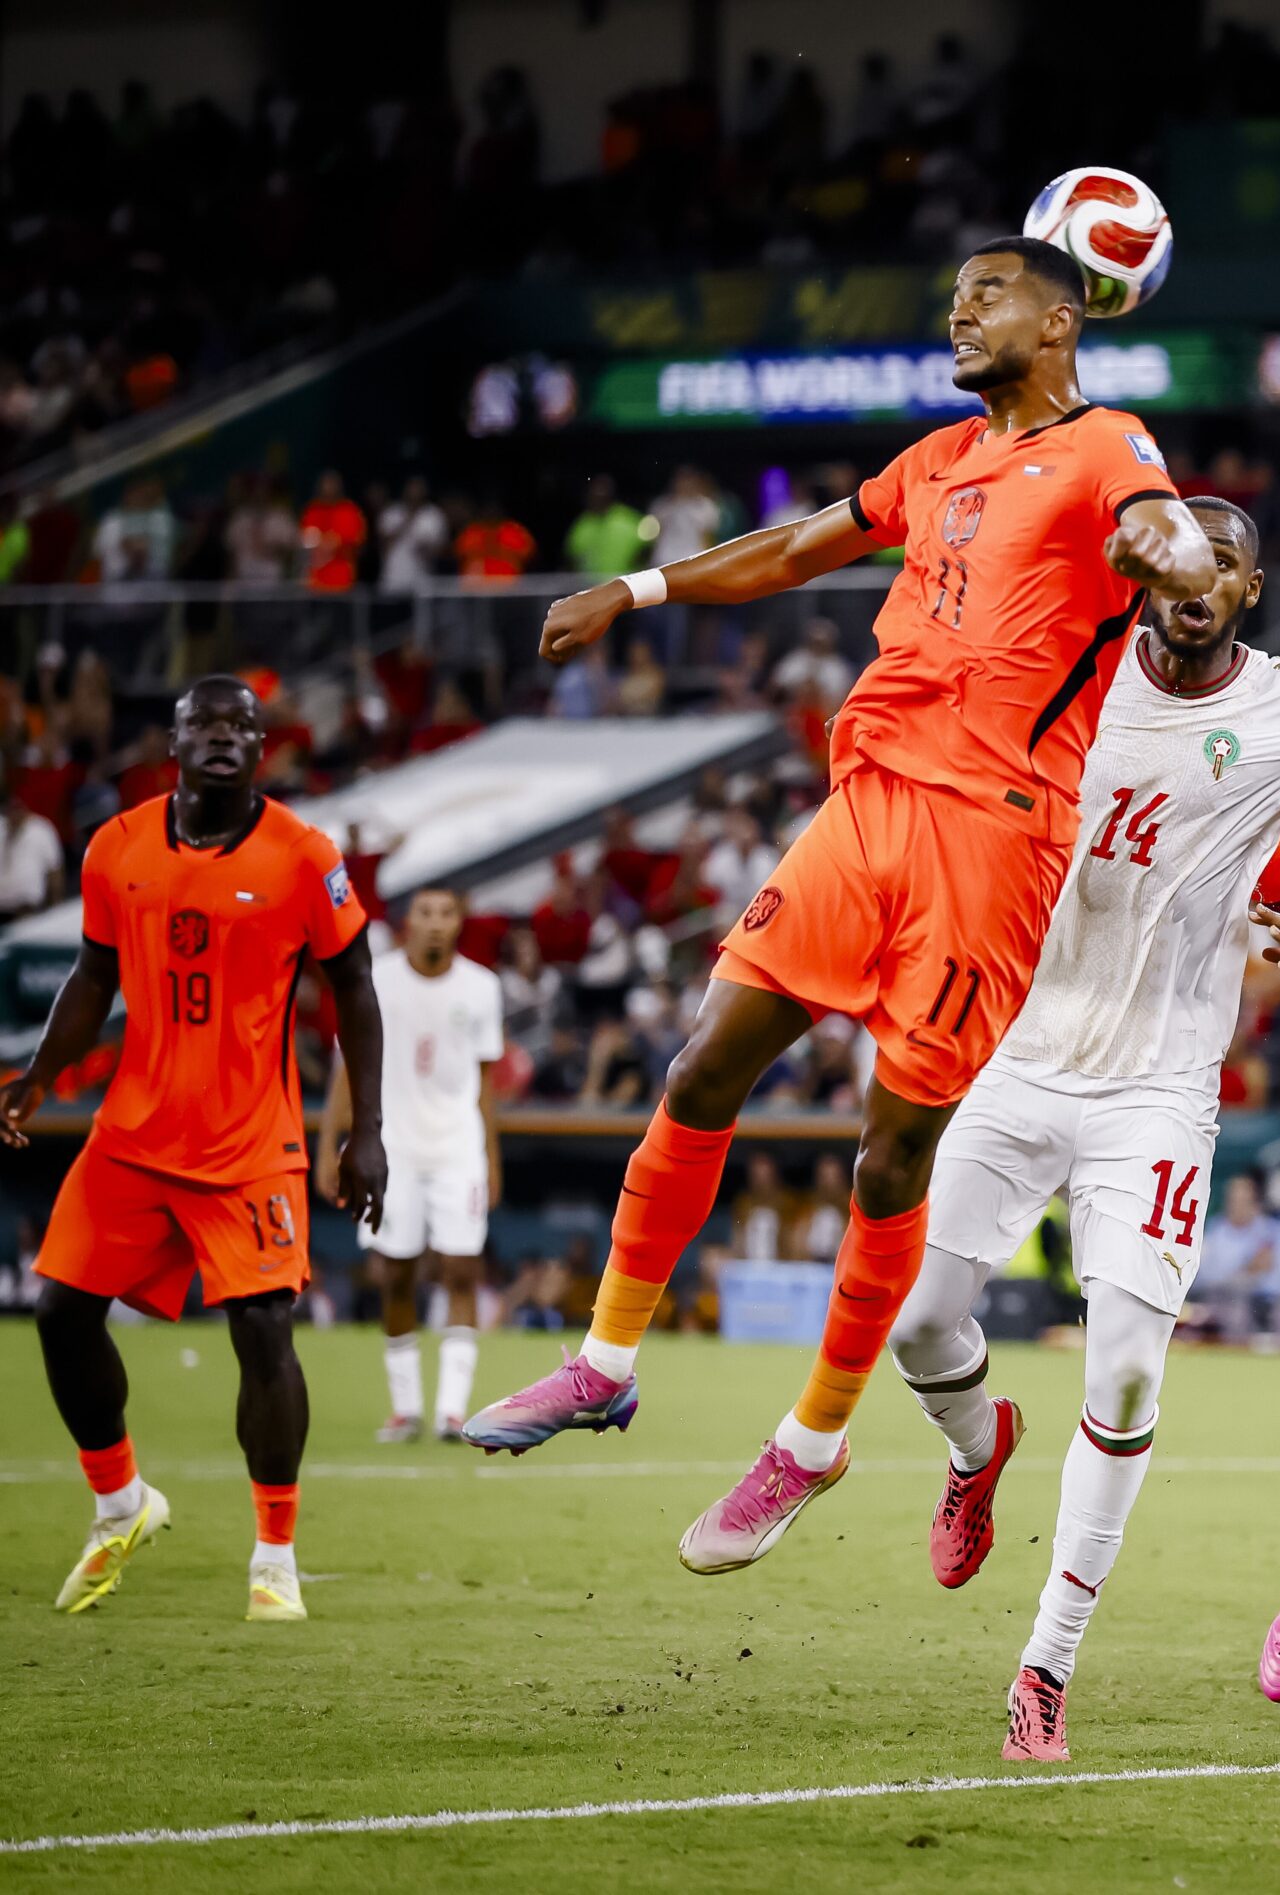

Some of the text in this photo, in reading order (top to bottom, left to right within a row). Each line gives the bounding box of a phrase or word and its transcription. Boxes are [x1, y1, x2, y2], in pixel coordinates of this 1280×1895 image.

[1089, 787, 1170, 867] 14
[167, 970, 210, 1025] 19
[926, 956, 981, 1037] 11
[245, 1194, 295, 1251] 19
[1140, 1159, 1200, 1247] 14
